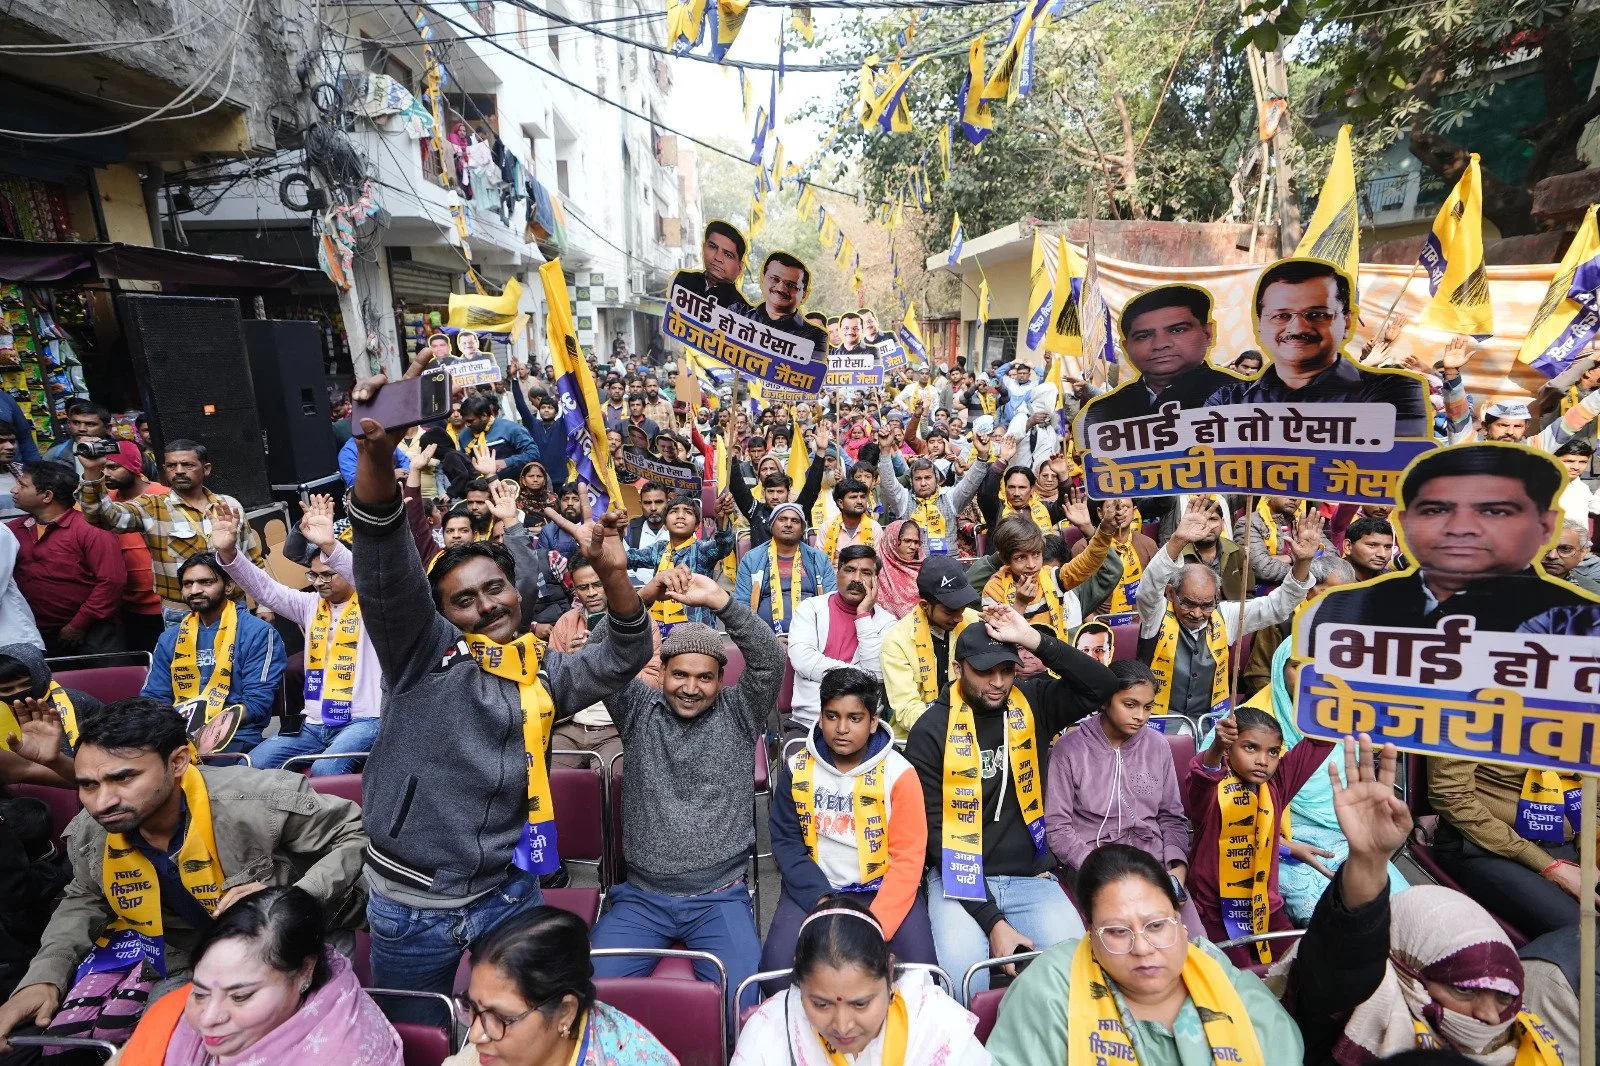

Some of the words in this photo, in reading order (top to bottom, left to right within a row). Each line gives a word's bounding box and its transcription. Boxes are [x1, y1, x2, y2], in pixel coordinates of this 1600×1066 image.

[676, 288, 718, 324] भाई
[719, 313, 736, 335] हो
[739, 322, 758, 343] तो
[760, 328, 805, 361] ऐसा..
[668, 307, 773, 377] केजरीवाल
[774, 362, 817, 390] जैसा
[832, 359, 842, 369] तो
[856, 373, 878, 385] जैसा
[1097, 403, 1180, 452] भाई
[1191, 411, 1227, 444] हो
[1234, 407, 1274, 443] तो
[1279, 407, 1381, 446] ऐसा..
[1092, 445, 1319, 494] केजरीवाल
[1322, 459, 1400, 499] जैस
[1329, 618, 1472, 685] भाई
[1488, 641, 1559, 690] हो
[333, 662, 355, 672] आदमी
[337, 672, 351, 681] पार्टी
[1009, 717, 1026, 731] पार्टी
[1309, 673, 1600, 766] केजरीवा
[948, 731, 974, 745] आदमी
[955, 743, 972, 757] पार्टी
[1018, 759, 1031, 770] आम
[1017, 767, 1034, 784] आदमी
[955, 787, 975, 796] आम
[951, 798, 980, 811] आदमी
[1233, 792, 1250, 806] पार्टी
[957, 810, 976, 824] पार्टी
[1229, 835, 1248, 844] आम
[954, 852, 976, 862] आम
[1226, 845, 1254, 858] आदमी
[950, 861, 981, 875] आदमी
[1232, 857, 1251, 870] पार्टी
[956, 873, 977, 885] पार्टी
